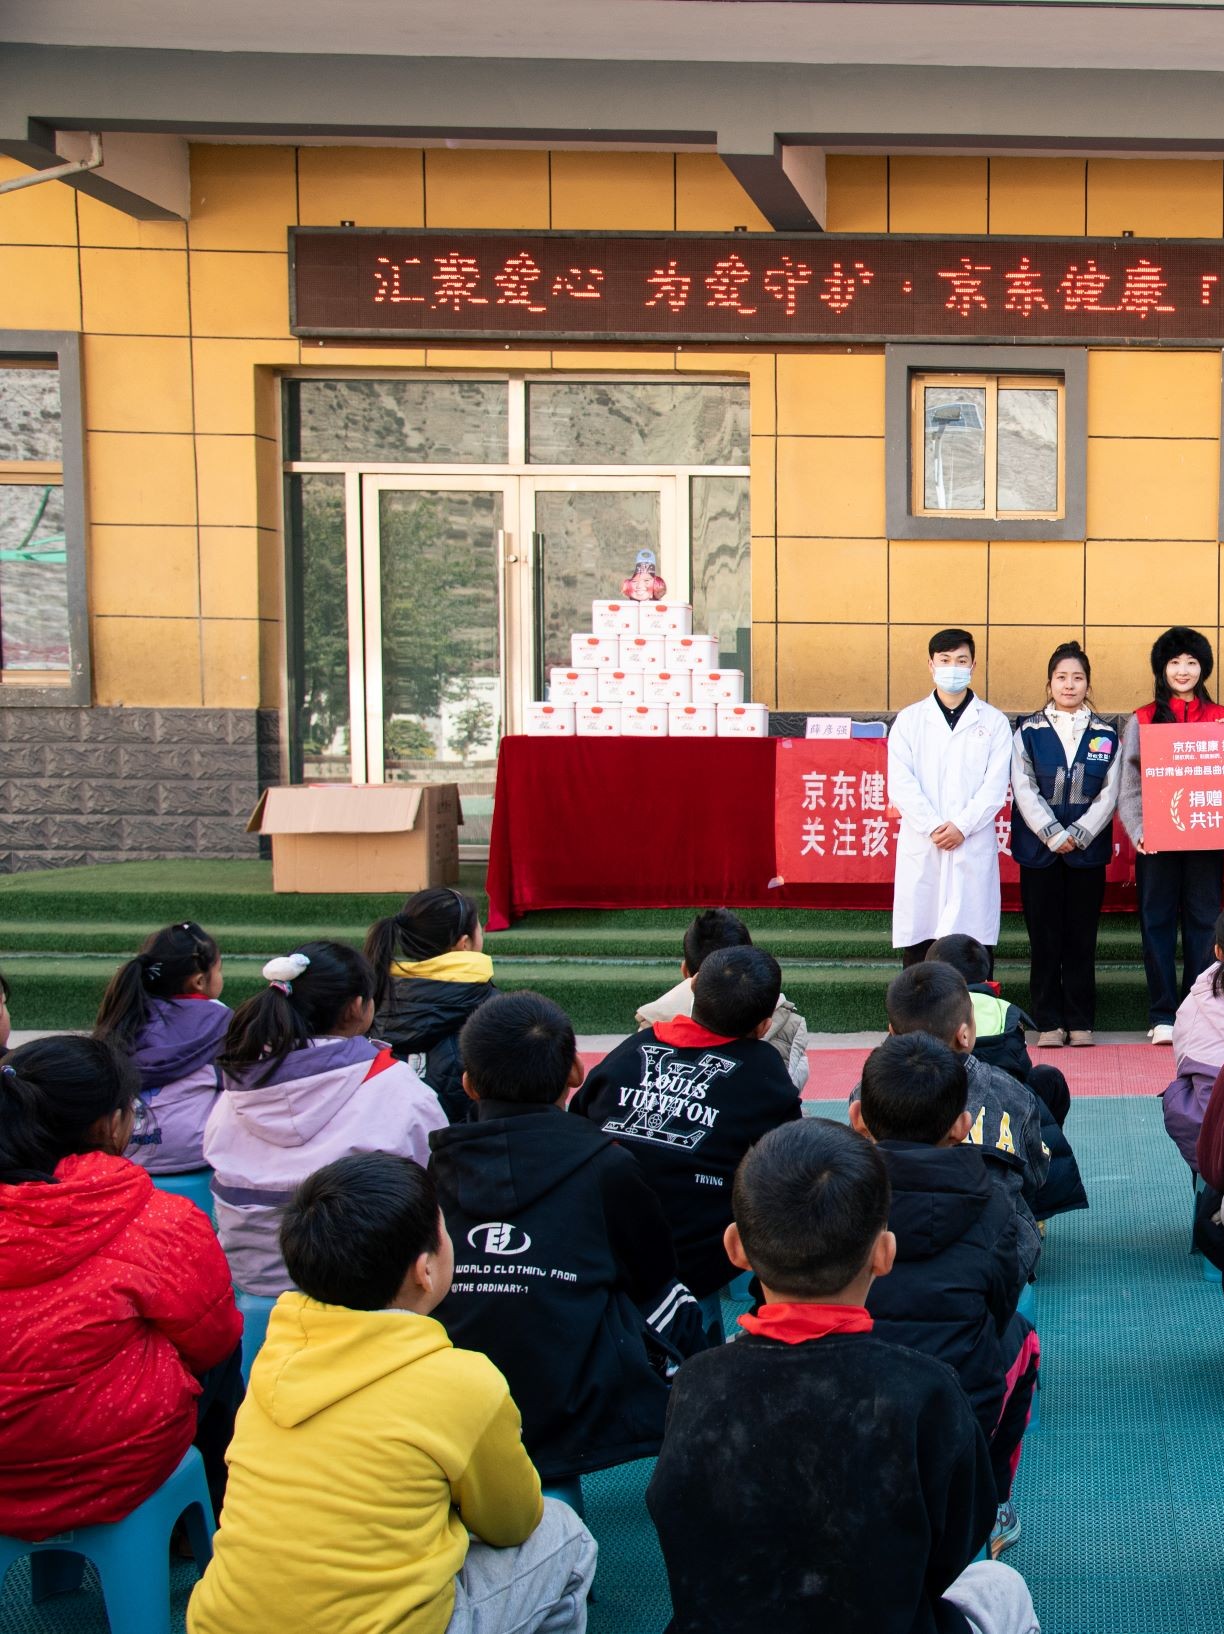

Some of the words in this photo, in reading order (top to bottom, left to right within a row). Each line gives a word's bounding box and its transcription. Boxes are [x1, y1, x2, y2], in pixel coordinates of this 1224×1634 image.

[373, 252, 604, 313] 汇聚爱心
[1173, 741, 1219, 753] 京东健康
[801, 770, 900, 811] 京东健
[1190, 811, 1223, 829] 共计
[639, 1071, 710, 1100] LOUIS
[617, 1086, 720, 1128] VUITTON
[694, 1173, 724, 1186] TRYING
[455, 1264, 491, 1274] WORLD
[550, 1268, 578, 1282] FROM
